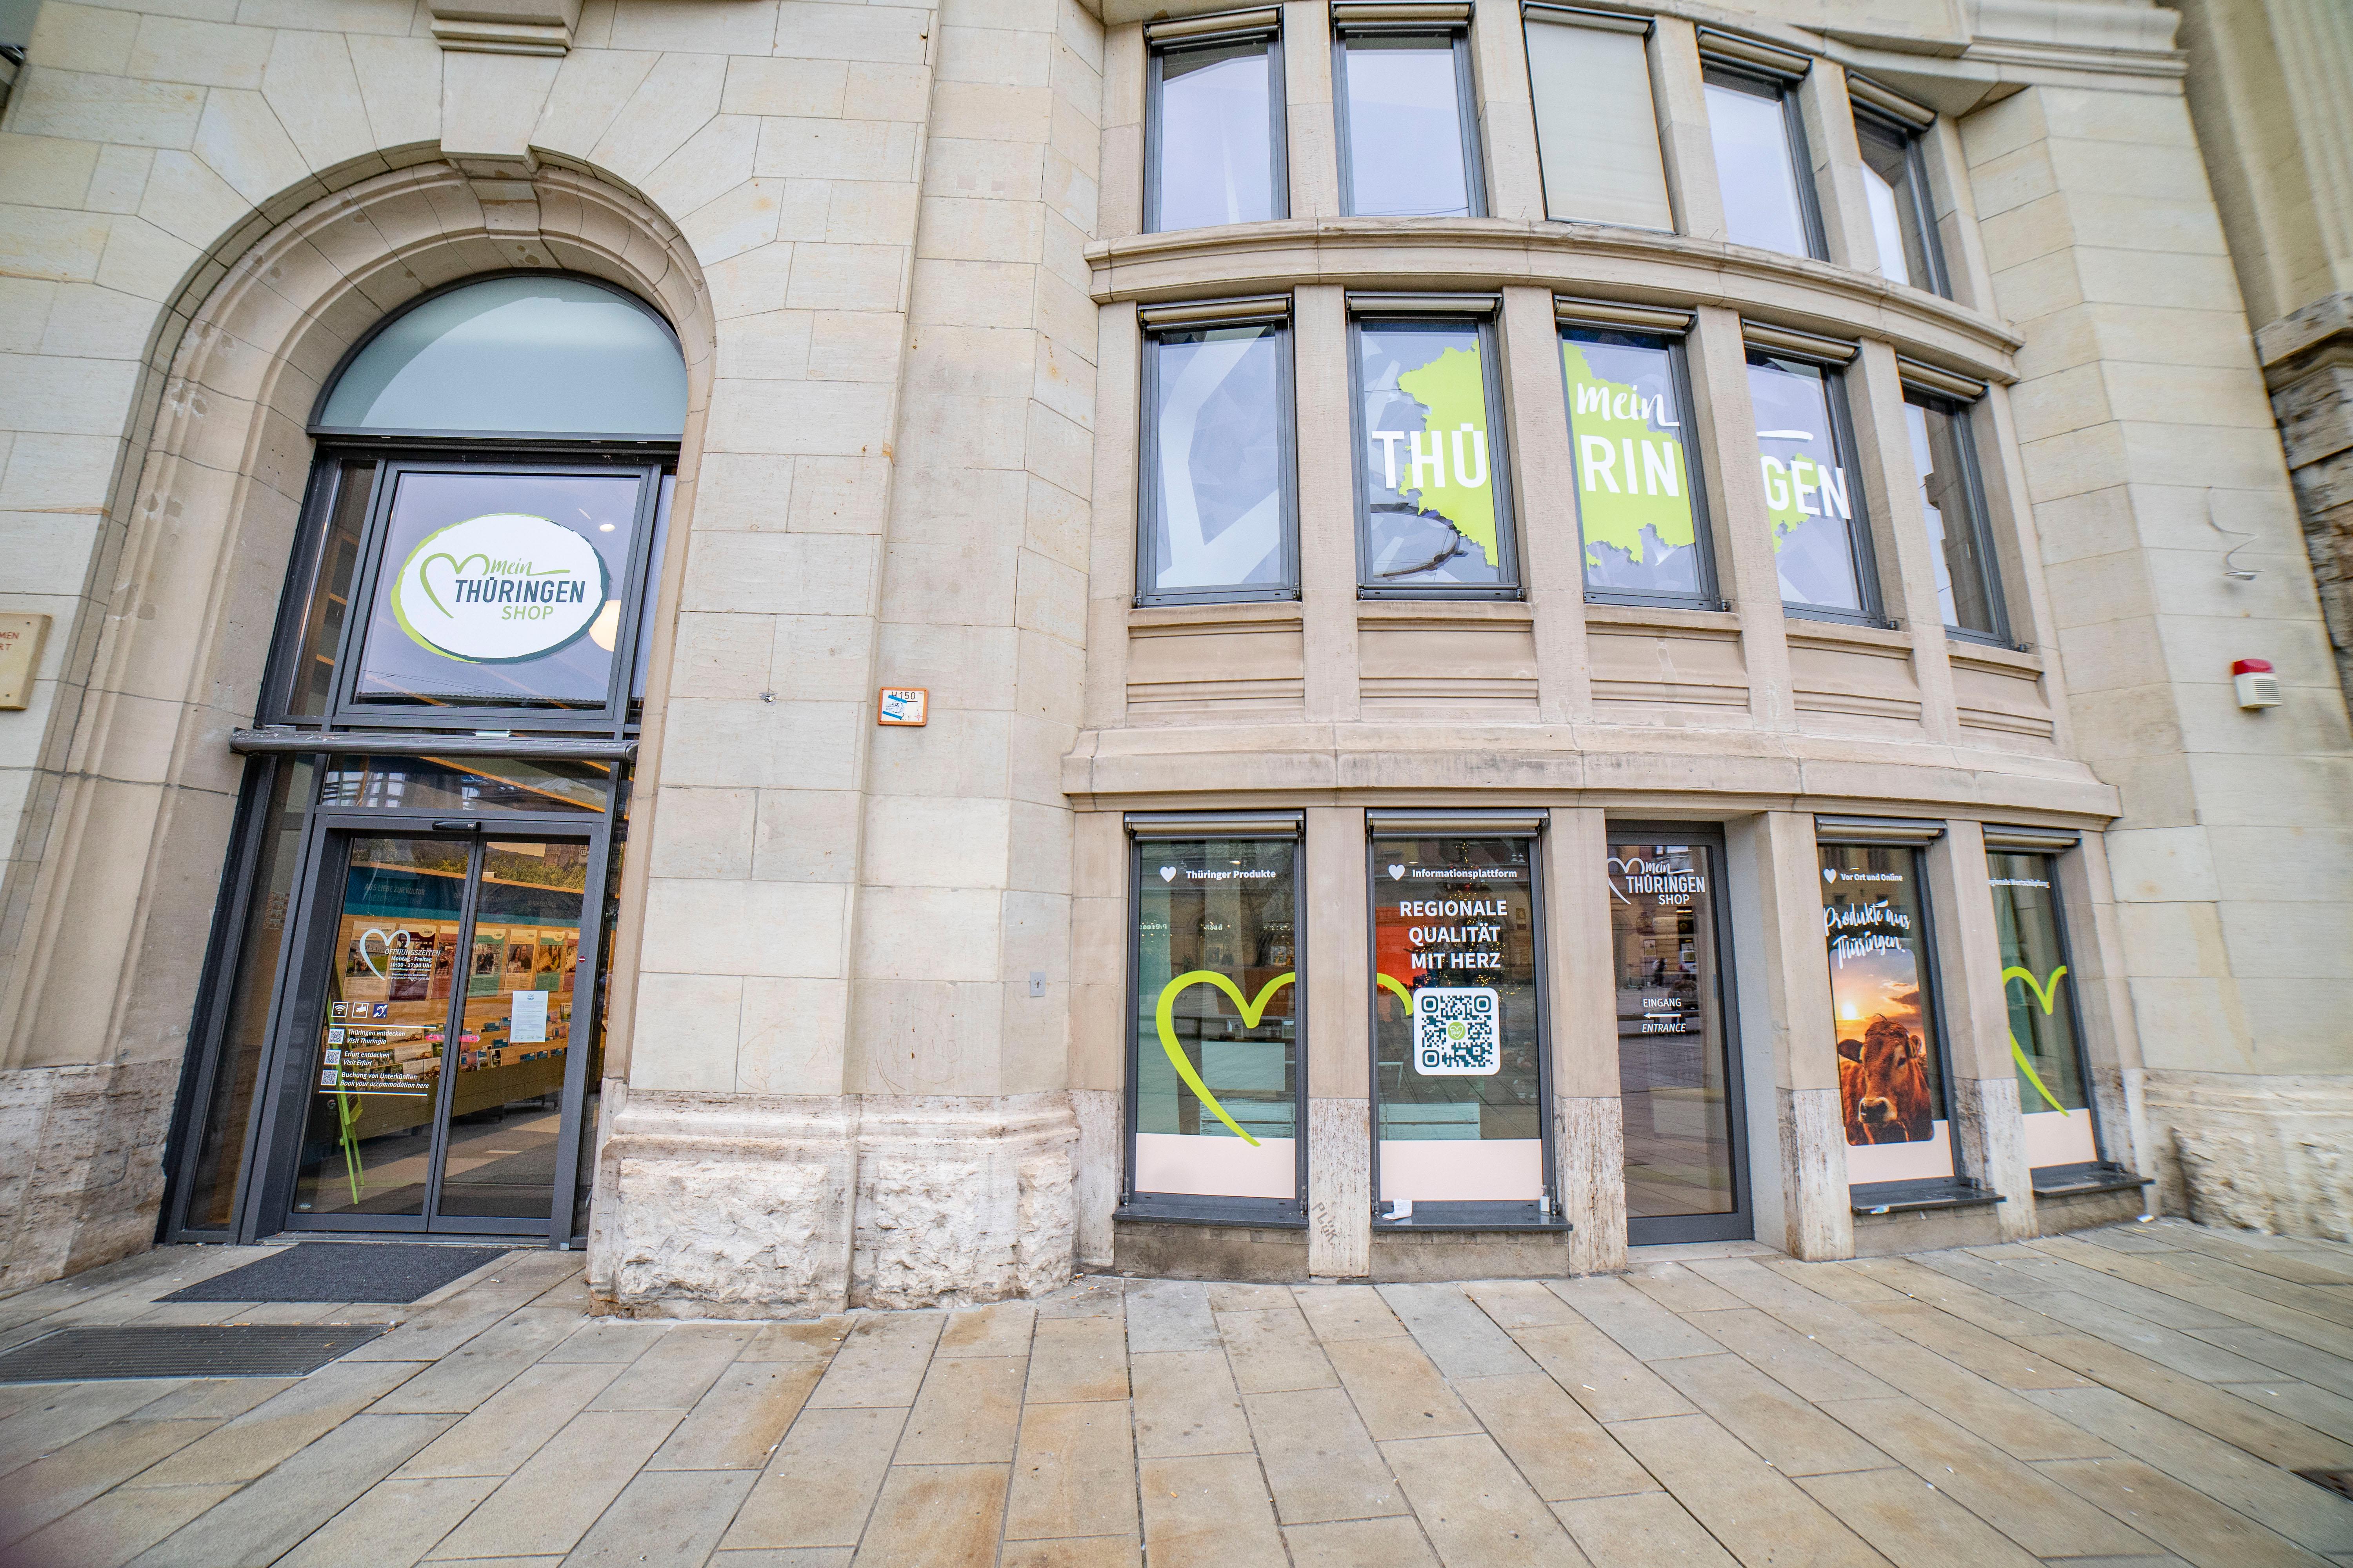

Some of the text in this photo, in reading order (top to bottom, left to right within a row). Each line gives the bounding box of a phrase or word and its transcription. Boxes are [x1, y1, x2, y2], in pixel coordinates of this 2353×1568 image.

[1577, 383, 1679, 426] mein
[1580, 434, 1679, 497] RIN
[1760, 456, 1851, 520] GEN
[490, 558, 570, 576] mein
[455, 577, 585, 603] THÜRINGEN
[502, 606, 553, 620] SHOP
[1186, 869, 1276, 880] Thüringer Produkte
[1412, 869, 1517, 879] Informationsplattform
[1646, 861, 1694, 874] mein
[1626, 874, 1705, 893] THÜRINGEN
[1880, 873, 1903, 881] Online
[1659, 894, 1689, 905] SHOP
[1400, 900, 1507, 917] REGIONALE
[1823, 899, 1911, 936] Produkte aus
[1409, 923, 1500, 946] QUALITÄT
[385, 948, 441, 956] ÖFFNUNGSZEITEN
[1412, 953, 1501, 968] MIT HERZ
[1643, 998, 1681, 1007] EINGANG
[1642, 1023, 1686, 1033] ENTRANCE
